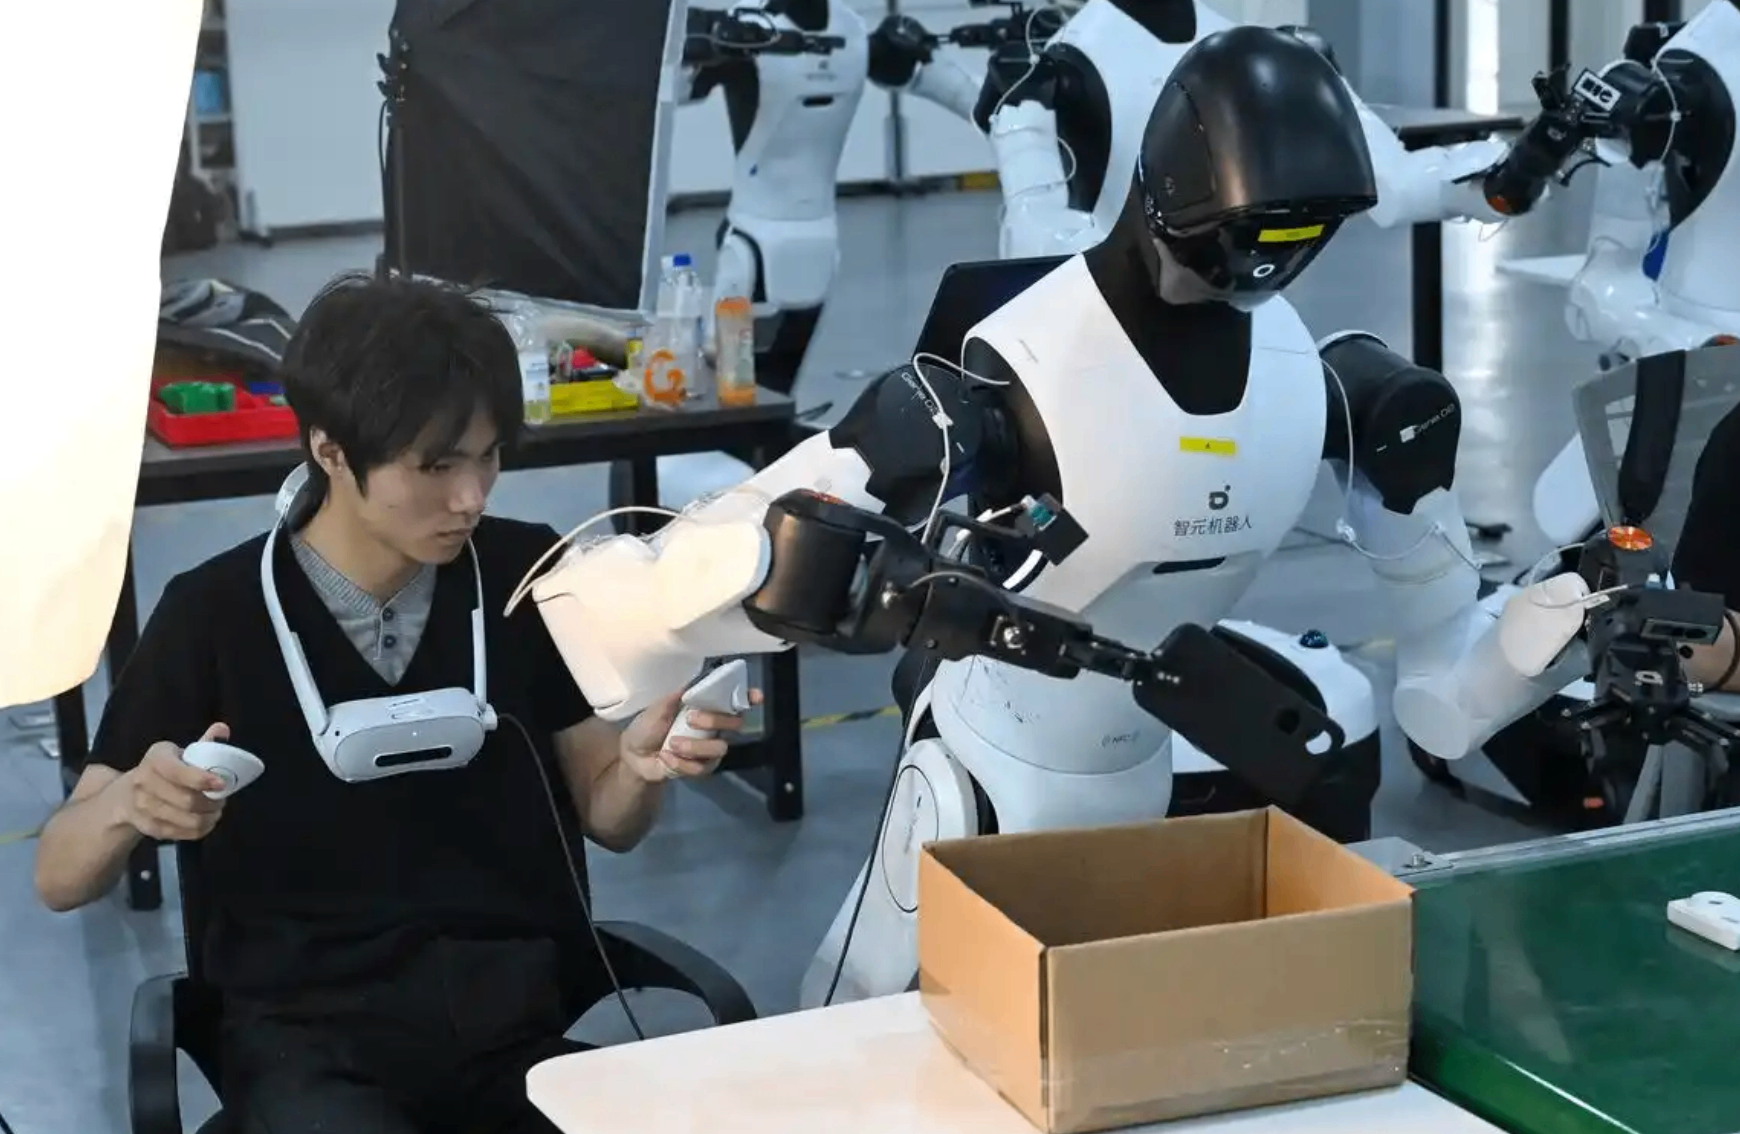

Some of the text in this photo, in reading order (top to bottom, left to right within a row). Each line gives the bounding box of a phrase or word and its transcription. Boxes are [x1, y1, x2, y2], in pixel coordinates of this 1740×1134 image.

[1173, 515, 1252, 537] 智元机器人
